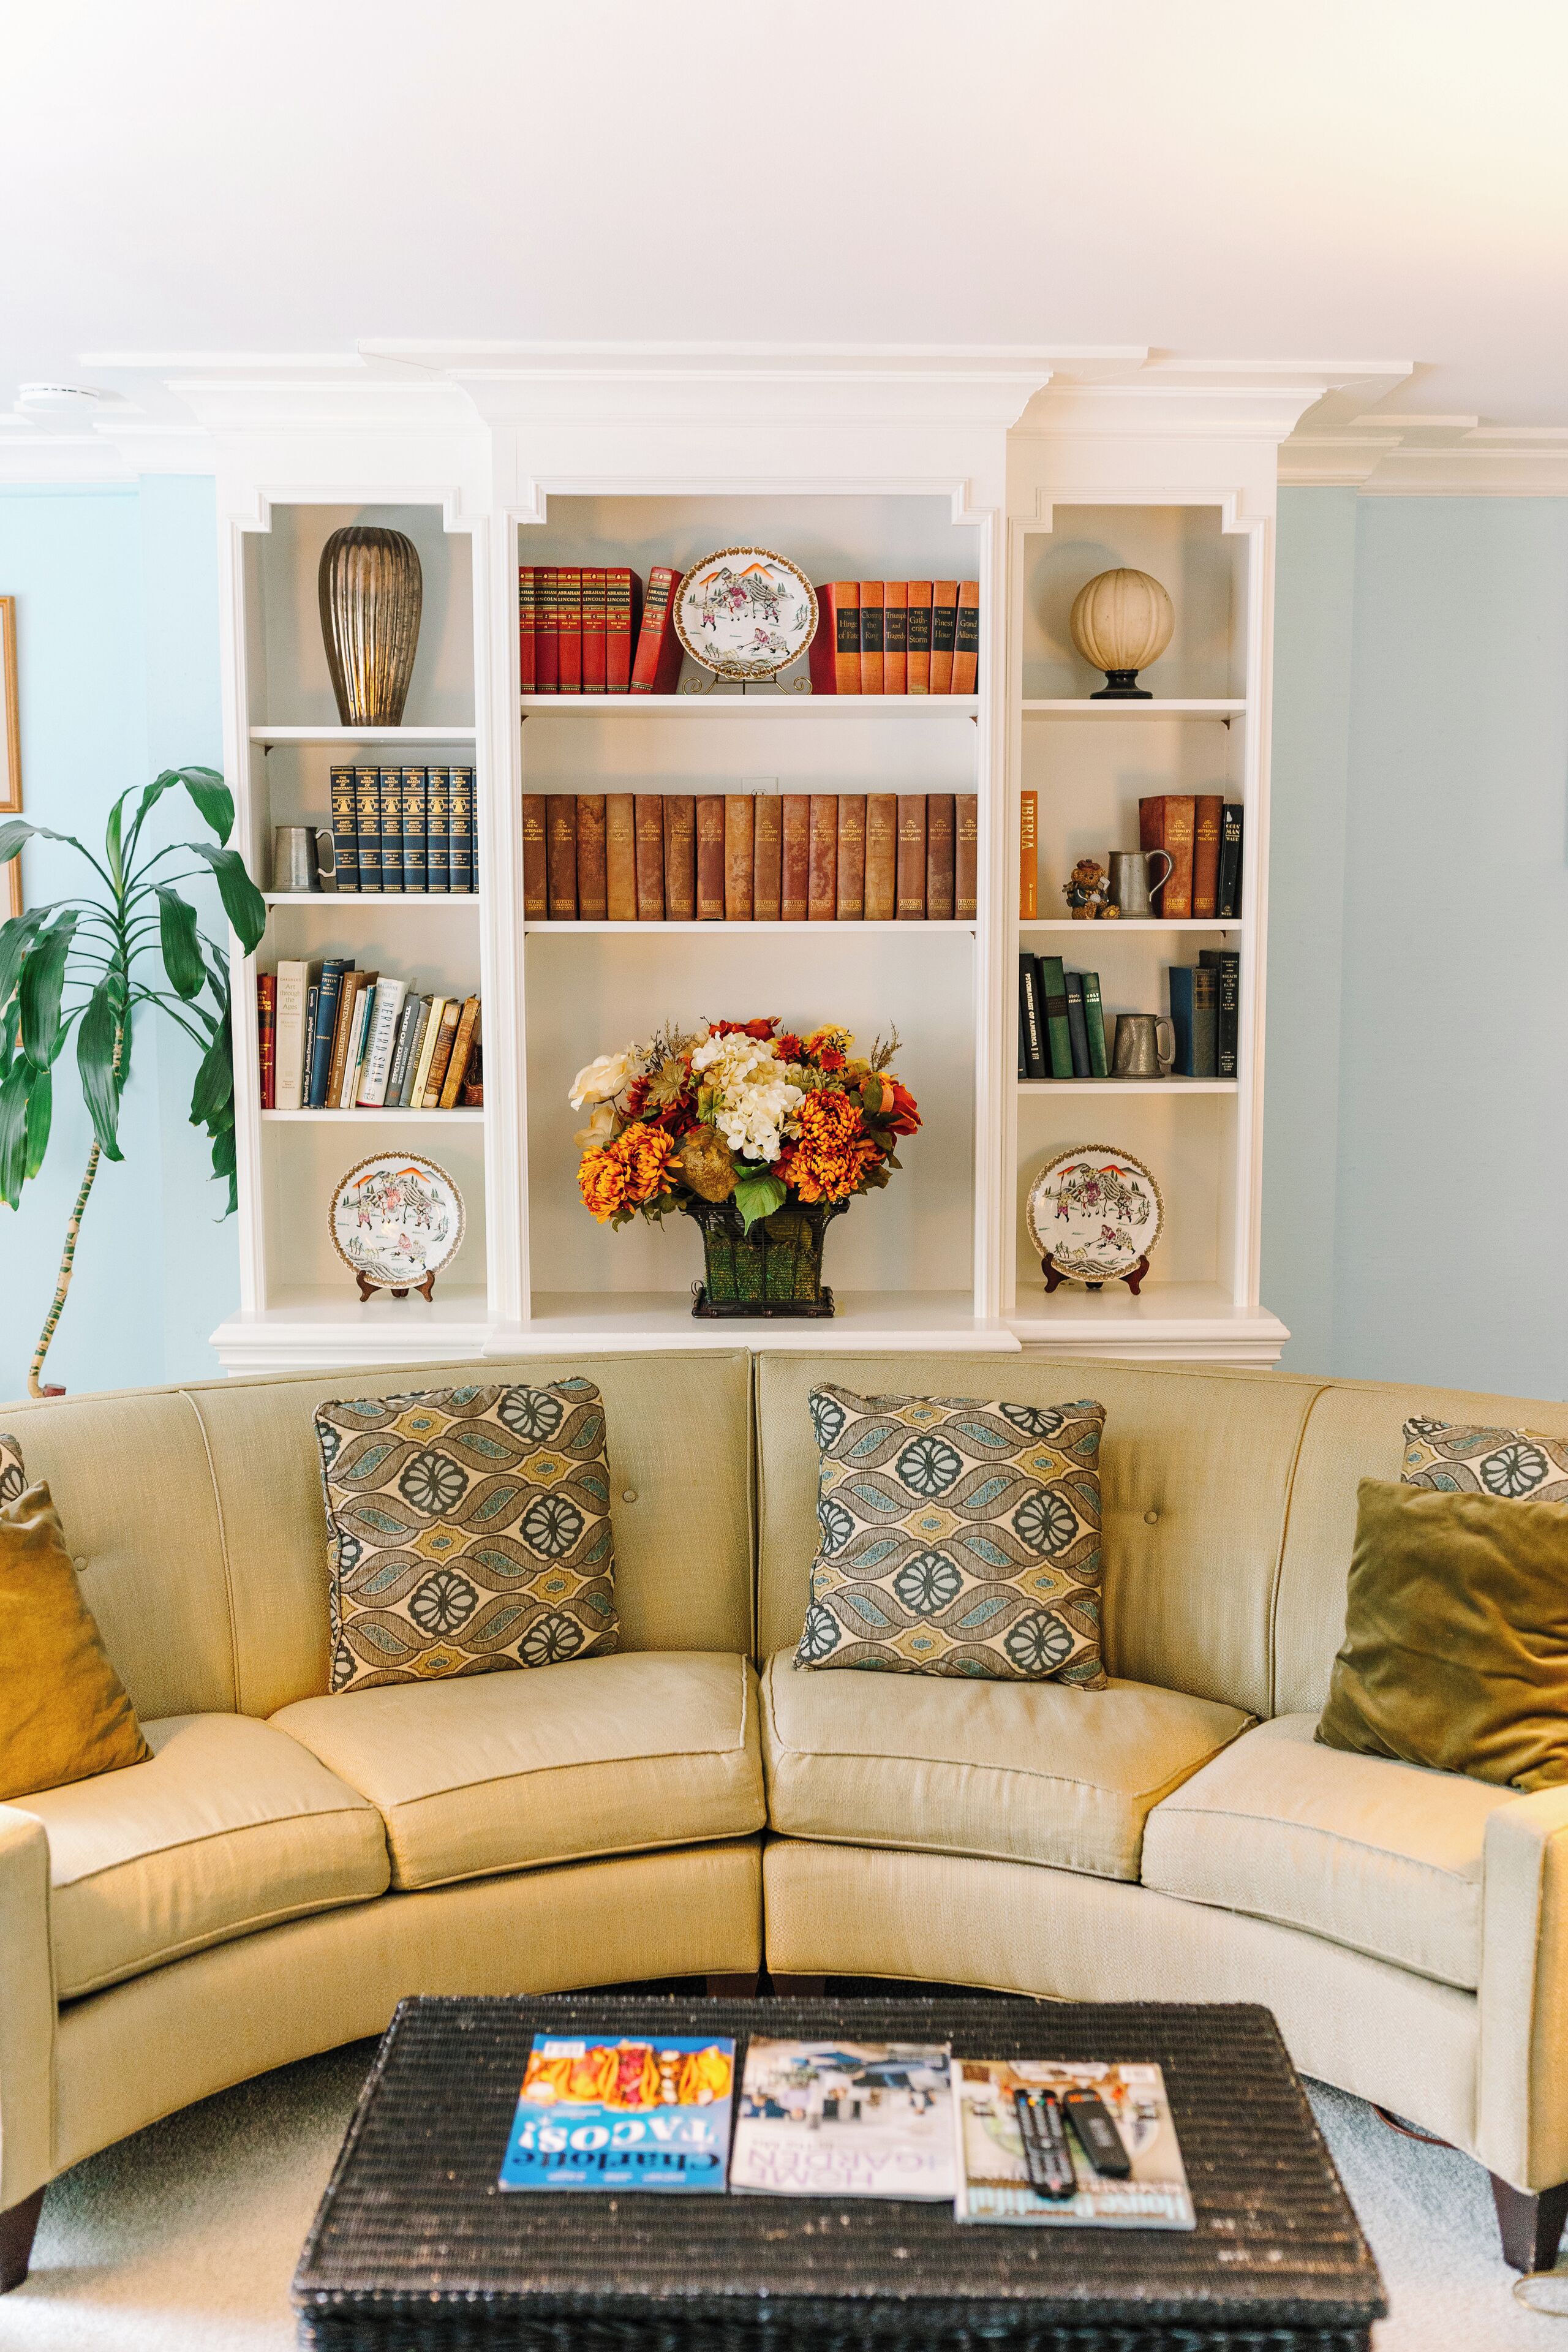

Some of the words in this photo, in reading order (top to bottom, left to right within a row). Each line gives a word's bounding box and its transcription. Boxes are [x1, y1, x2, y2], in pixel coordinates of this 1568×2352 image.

[839, 620, 858, 628] Hinge
[861, 611, 883, 620] Closing
[886, 611, 907, 620] Triumph
[935, 617, 953, 627] Finest
[839, 630, 845, 639] of
[865, 632, 878, 641] Ring
[886, 631, 905, 641] Tragedy
[911, 625, 928, 633] ering
[957, 631, 978, 639] Alliance
[1022, 799, 1035, 850] IBERIA
[343, 979, 353, 1022] AKHENATEN
[1025, 973, 1034, 1012] PSYCHIATRIST
[375, 1001, 394, 1052] BERNARD
[1029, 1019, 1038, 1047] AMERICA
[399, 1033, 407, 1046] OF
[416, 1022, 428, 1058] MONARCH
[337, 1030, 345, 1067] NEFERTITI
[372, 1055, 385, 1085] SHAW
[391, 1046, 402, 1084] DRUMS
[413, 1061, 419, 1069] OF
[518, 2116, 718, 2153] TACOS!
[512, 2150, 721, 2172] Charlotte
